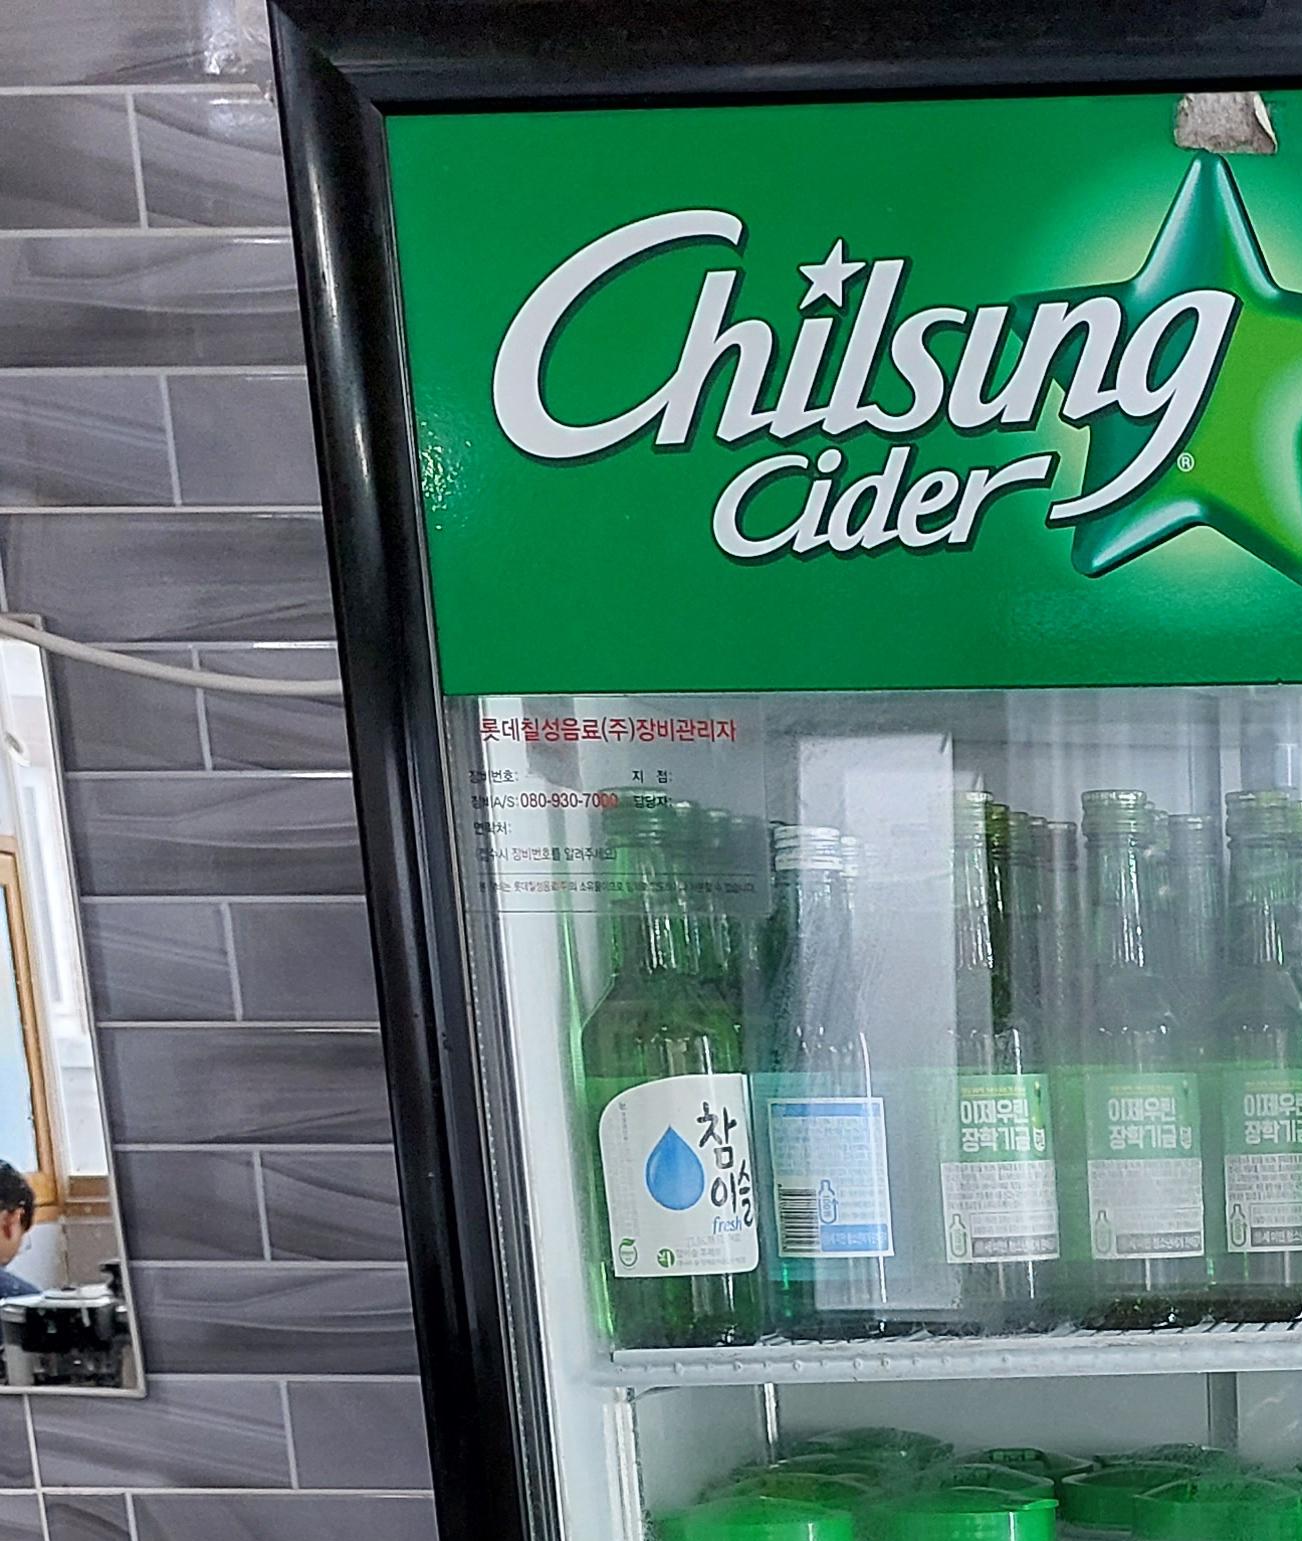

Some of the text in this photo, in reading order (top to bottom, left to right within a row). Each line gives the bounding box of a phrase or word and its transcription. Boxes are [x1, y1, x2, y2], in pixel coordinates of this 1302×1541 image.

[493, 209, 1237, 522] Chilsung
[712, 446, 1055, 559] Cider
[480, 716, 736, 743] 롯데칠성음료(주)장비관리자
[960, 1099, 1030, 1125] 이제우린
[1107, 1097, 1177, 1122] 이제우린
